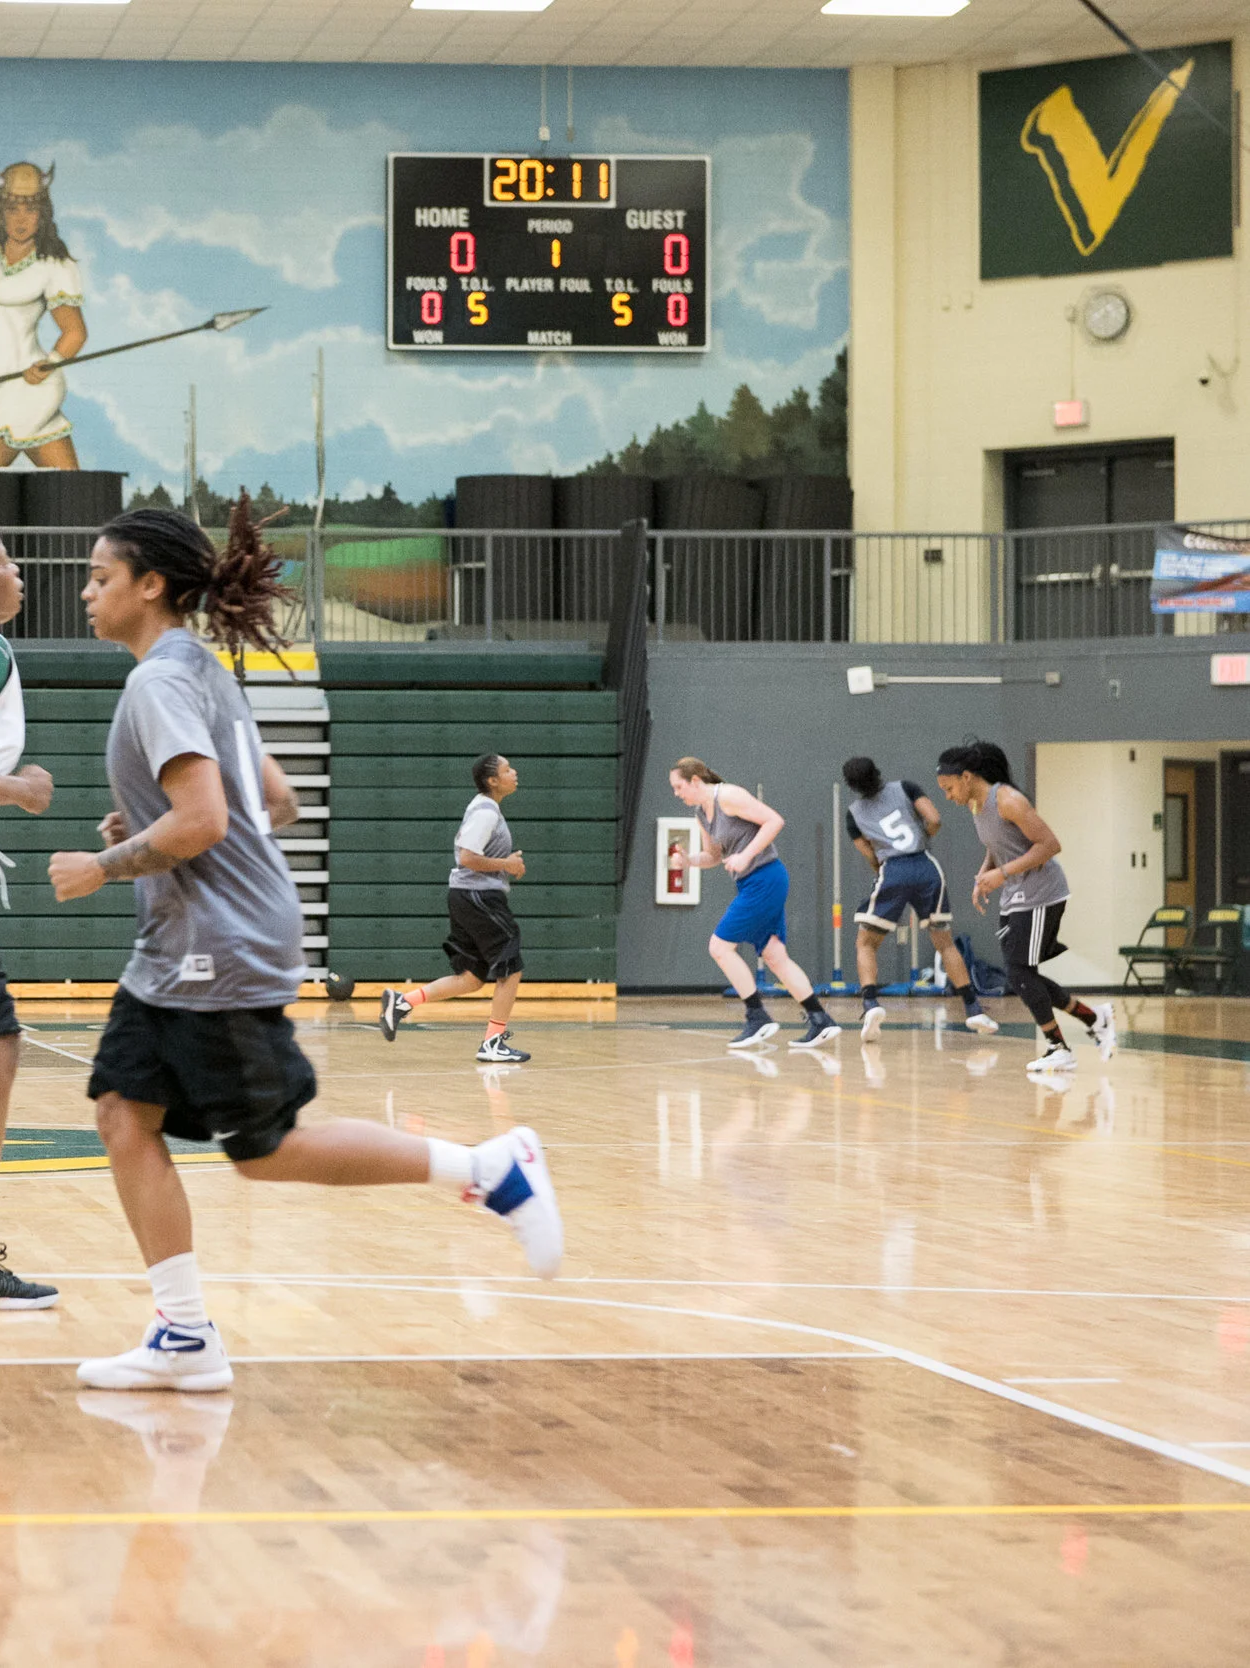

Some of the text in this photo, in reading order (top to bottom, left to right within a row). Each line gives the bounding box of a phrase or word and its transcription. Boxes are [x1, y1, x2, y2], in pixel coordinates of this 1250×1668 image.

[492, 159, 610, 202] 20:11
[415, 206, 470, 228] HOME
[527, 218, 573, 235] PERIOD
[625, 208, 687, 230] GUEST
[450, 231, 476, 274] 0
[551, 238, 562, 268] 1
[664, 233, 690, 276] 0
[406, 276, 448, 292] FOULS
[459, 277, 495, 293] T.O.L.
[505, 277, 593, 293] PLAYER FOUL
[604, 278, 640, 294] T.O.L.
[652, 278, 694, 294] FOULS
[421, 291, 443, 325] 0
[467, 291, 489, 326] 5
[611, 292, 633, 327] 5
[666, 292, 689, 327] 0
[412, 329, 444, 345] WON
[527, 330, 573, 346] MATCH
[657, 331, 689, 347] WON
[878, 809, 915, 850] 5
